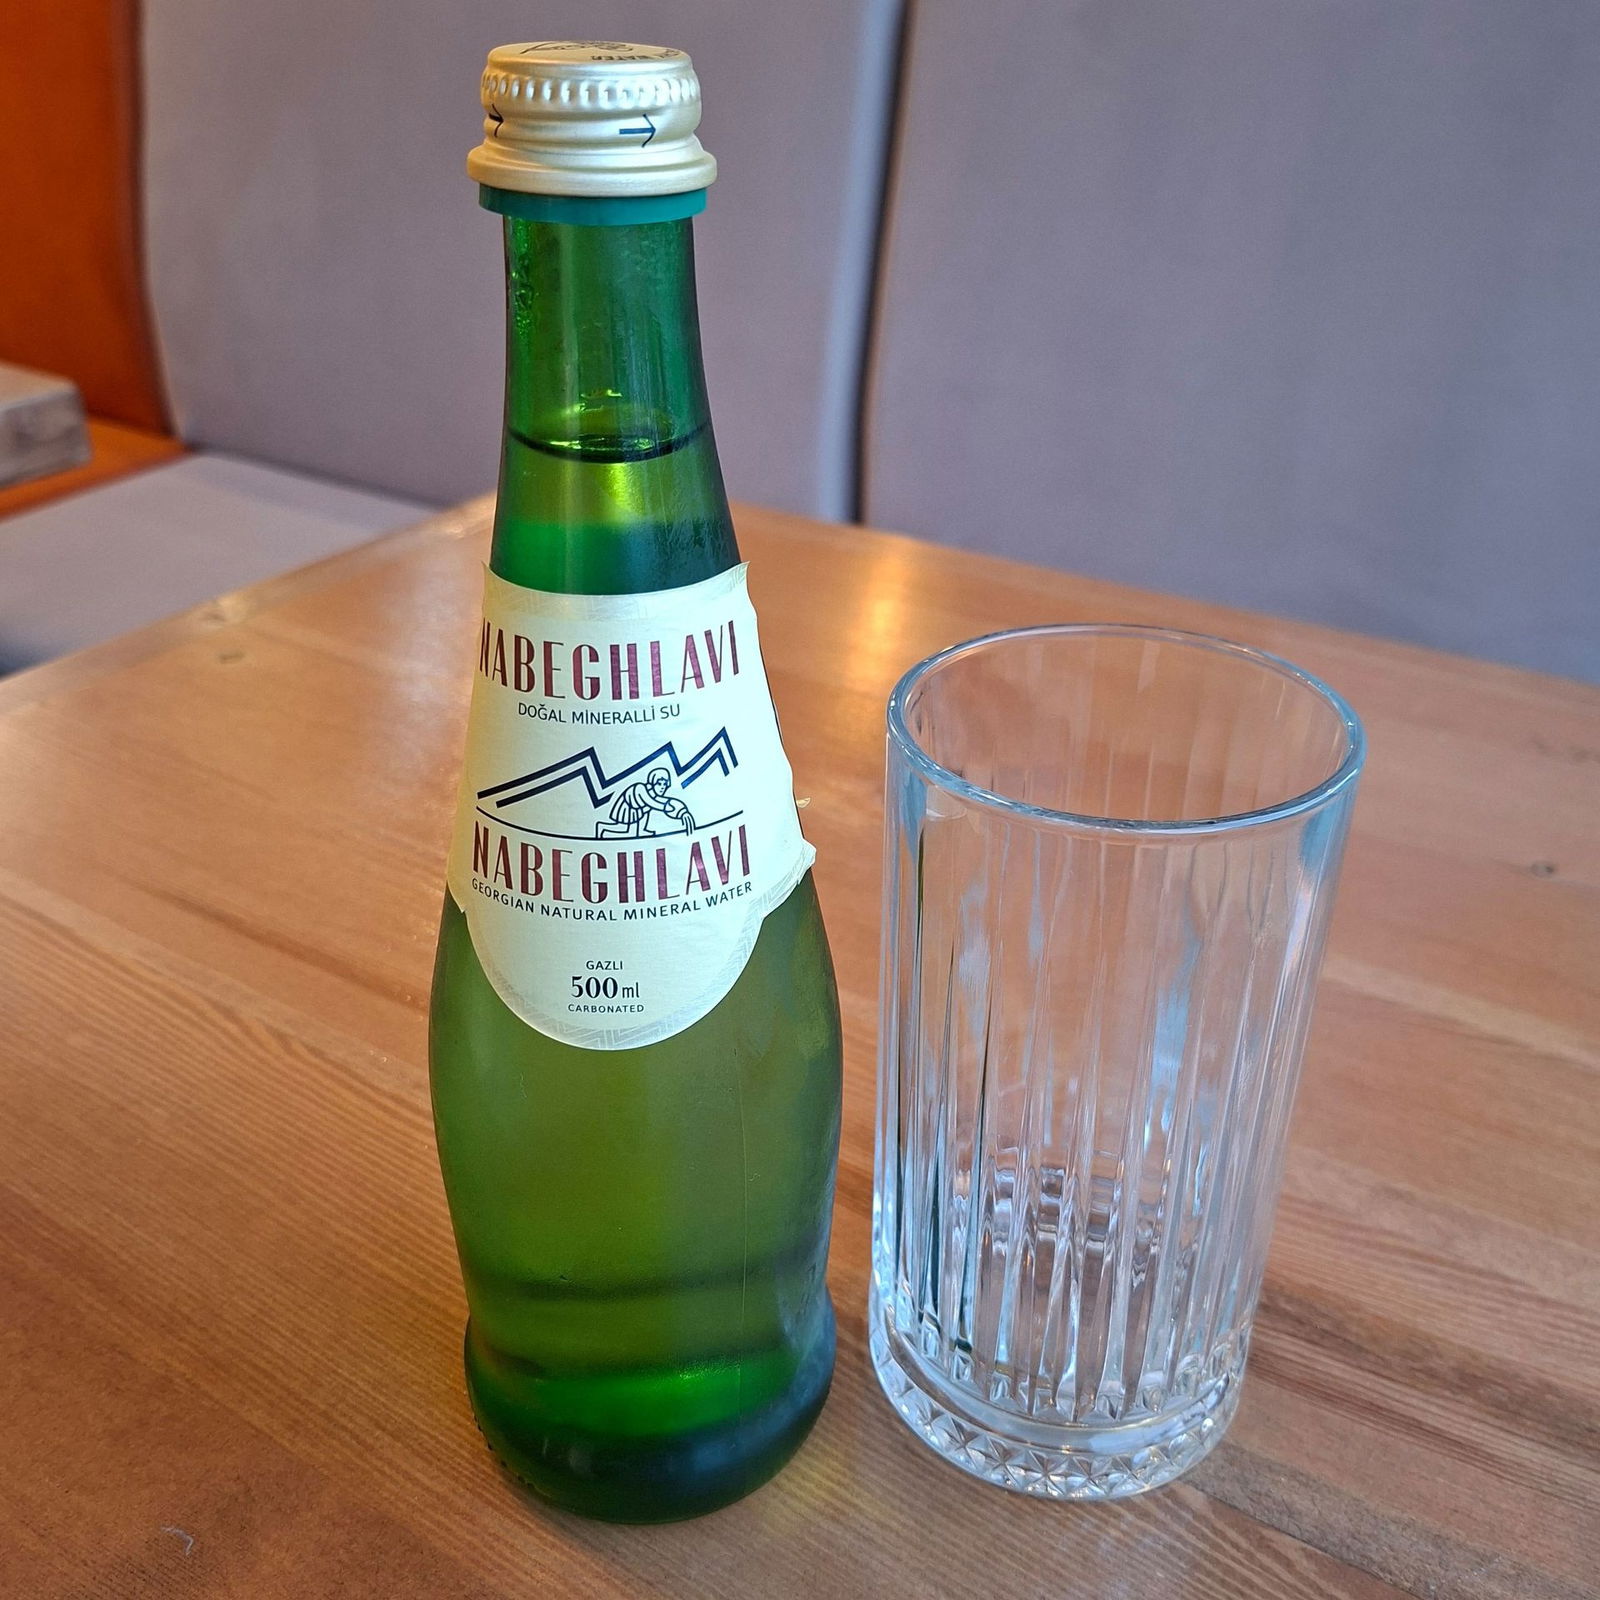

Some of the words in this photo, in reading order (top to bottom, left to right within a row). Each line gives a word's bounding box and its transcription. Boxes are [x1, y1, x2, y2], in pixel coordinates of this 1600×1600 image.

[479, 617, 740, 701] NABEGHLAVI
[517, 702, 567, 723] DOĞAL
[571, 705, 656, 725] MİNERALLİ
[660, 703, 681, 719] SU
[472, 820, 751, 904] NABEGHLAVI
[472, 878, 534, 912] GEORGIAN
[540, 904, 618, 921] NATURAL
[623, 900, 701, 920] MINERAL
[705, 881, 753, 907] WATER
[586, 960, 624, 971] GAZLI
[571, 975, 619, 999] 500
[622, 982, 640, 999] ml
[567, 1003, 645, 1013] CARBONATED
